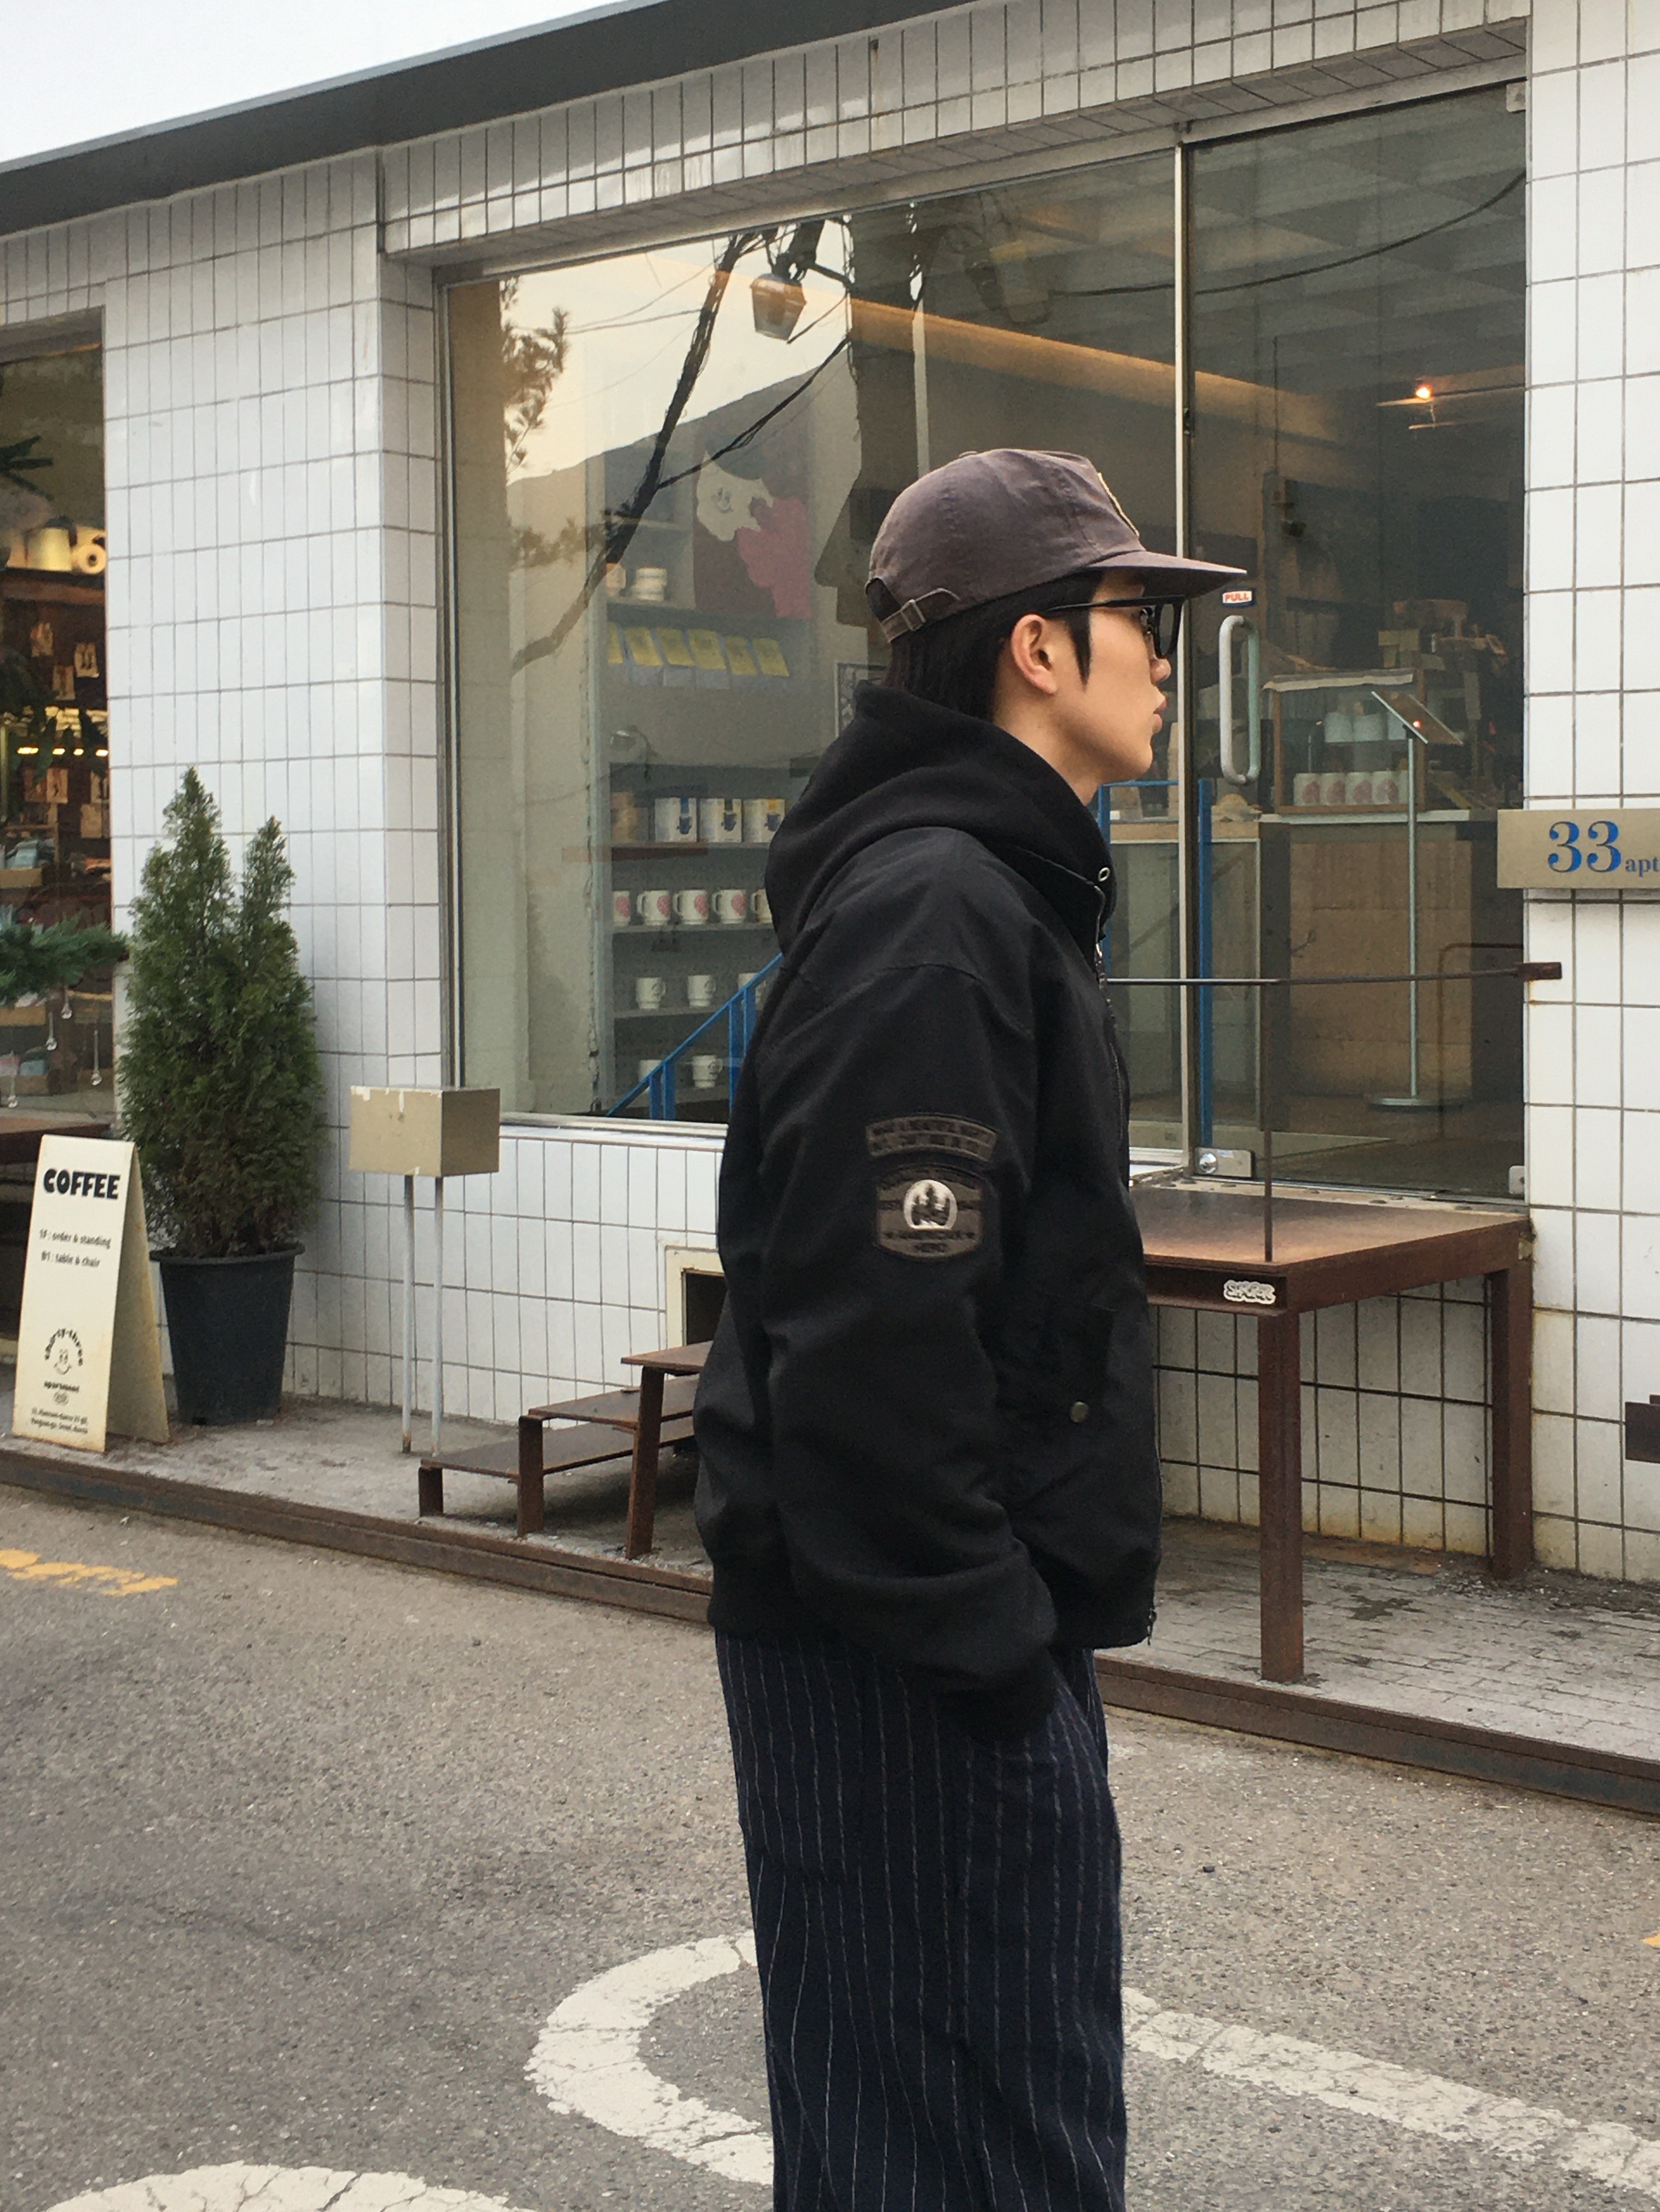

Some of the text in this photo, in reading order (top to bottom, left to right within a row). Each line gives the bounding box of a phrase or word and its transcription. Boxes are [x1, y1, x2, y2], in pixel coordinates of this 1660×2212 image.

[1225, 593, 1249, 602] PULL
[1548, 821, 1621, 873] 33
[44, 1168, 121, 1200] COFFEE
[52, 1231, 72, 1242] order
[80, 1235, 112, 1249] standing
[55, 1253, 74, 1264] table
[82, 1256, 100, 1268] chair
